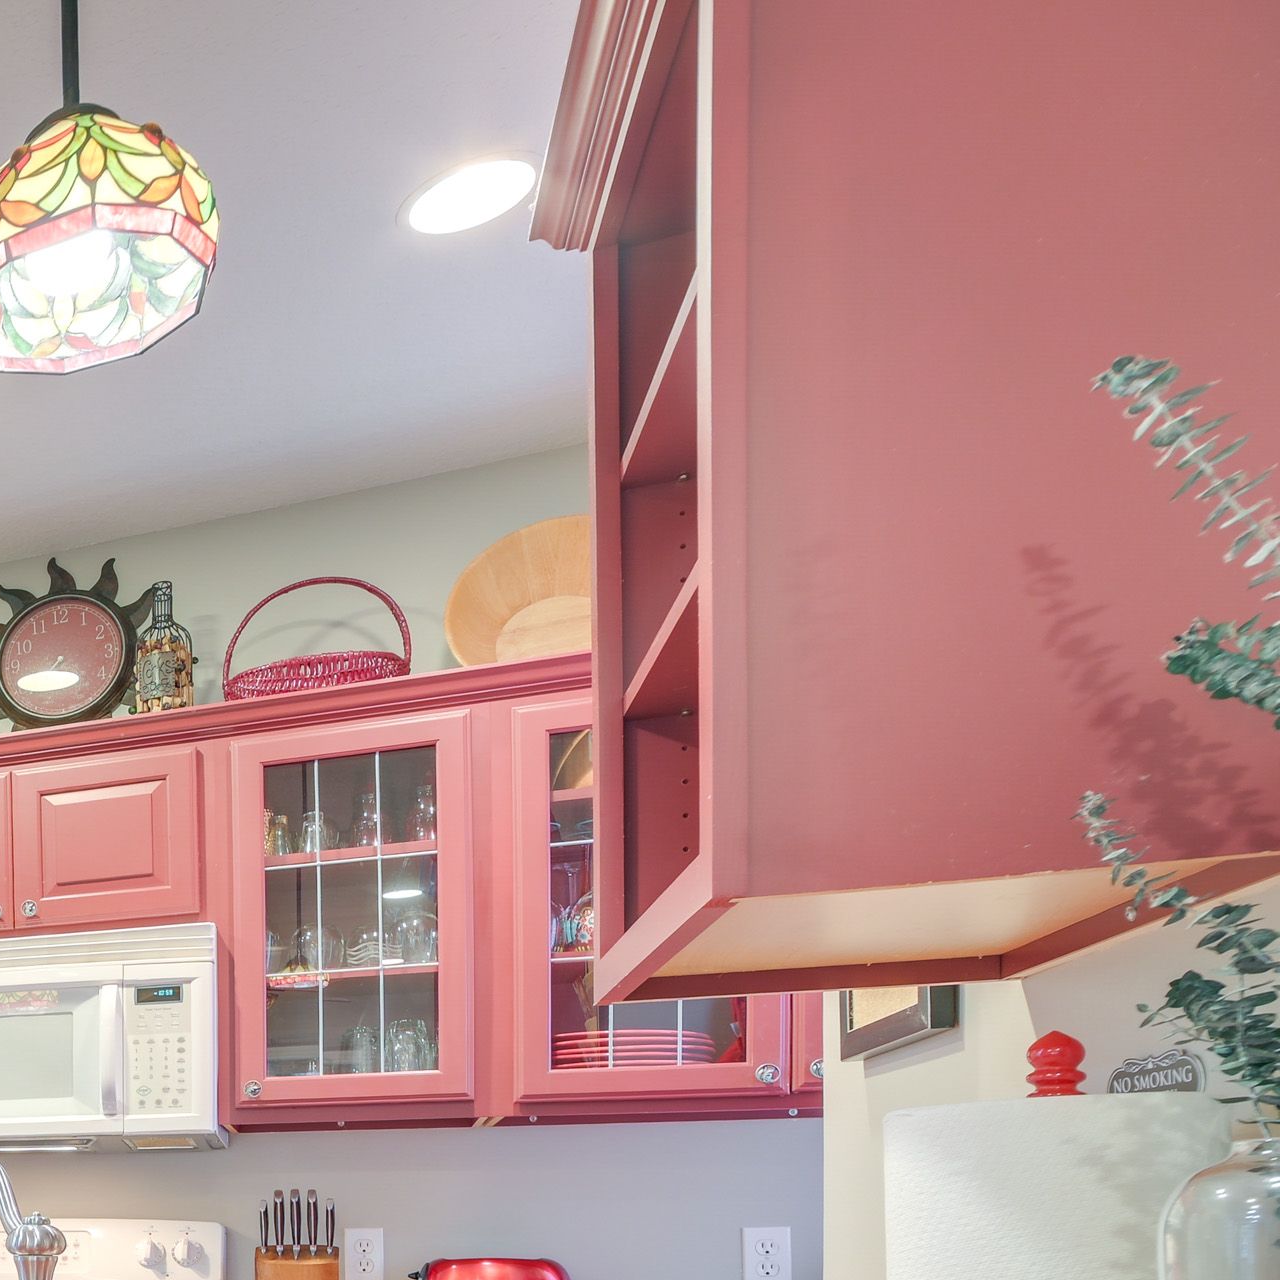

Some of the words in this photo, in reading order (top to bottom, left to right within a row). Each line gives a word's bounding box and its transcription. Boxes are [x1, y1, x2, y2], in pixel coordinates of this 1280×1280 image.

[52, 608, 69, 625] 12
[80, 612, 87, 626] 1
[31, 619, 47, 635] 11
[95, 624, 105, 640] 2
[16, 639, 32, 655] 10
[104, 643, 114, 658] 3
[11, 659, 20, 673] 9
[97, 666, 107, 680] 4
[1113, 1077, 1132, 1093] NO
[1134, 1065, 1193, 1091] SMOKING
